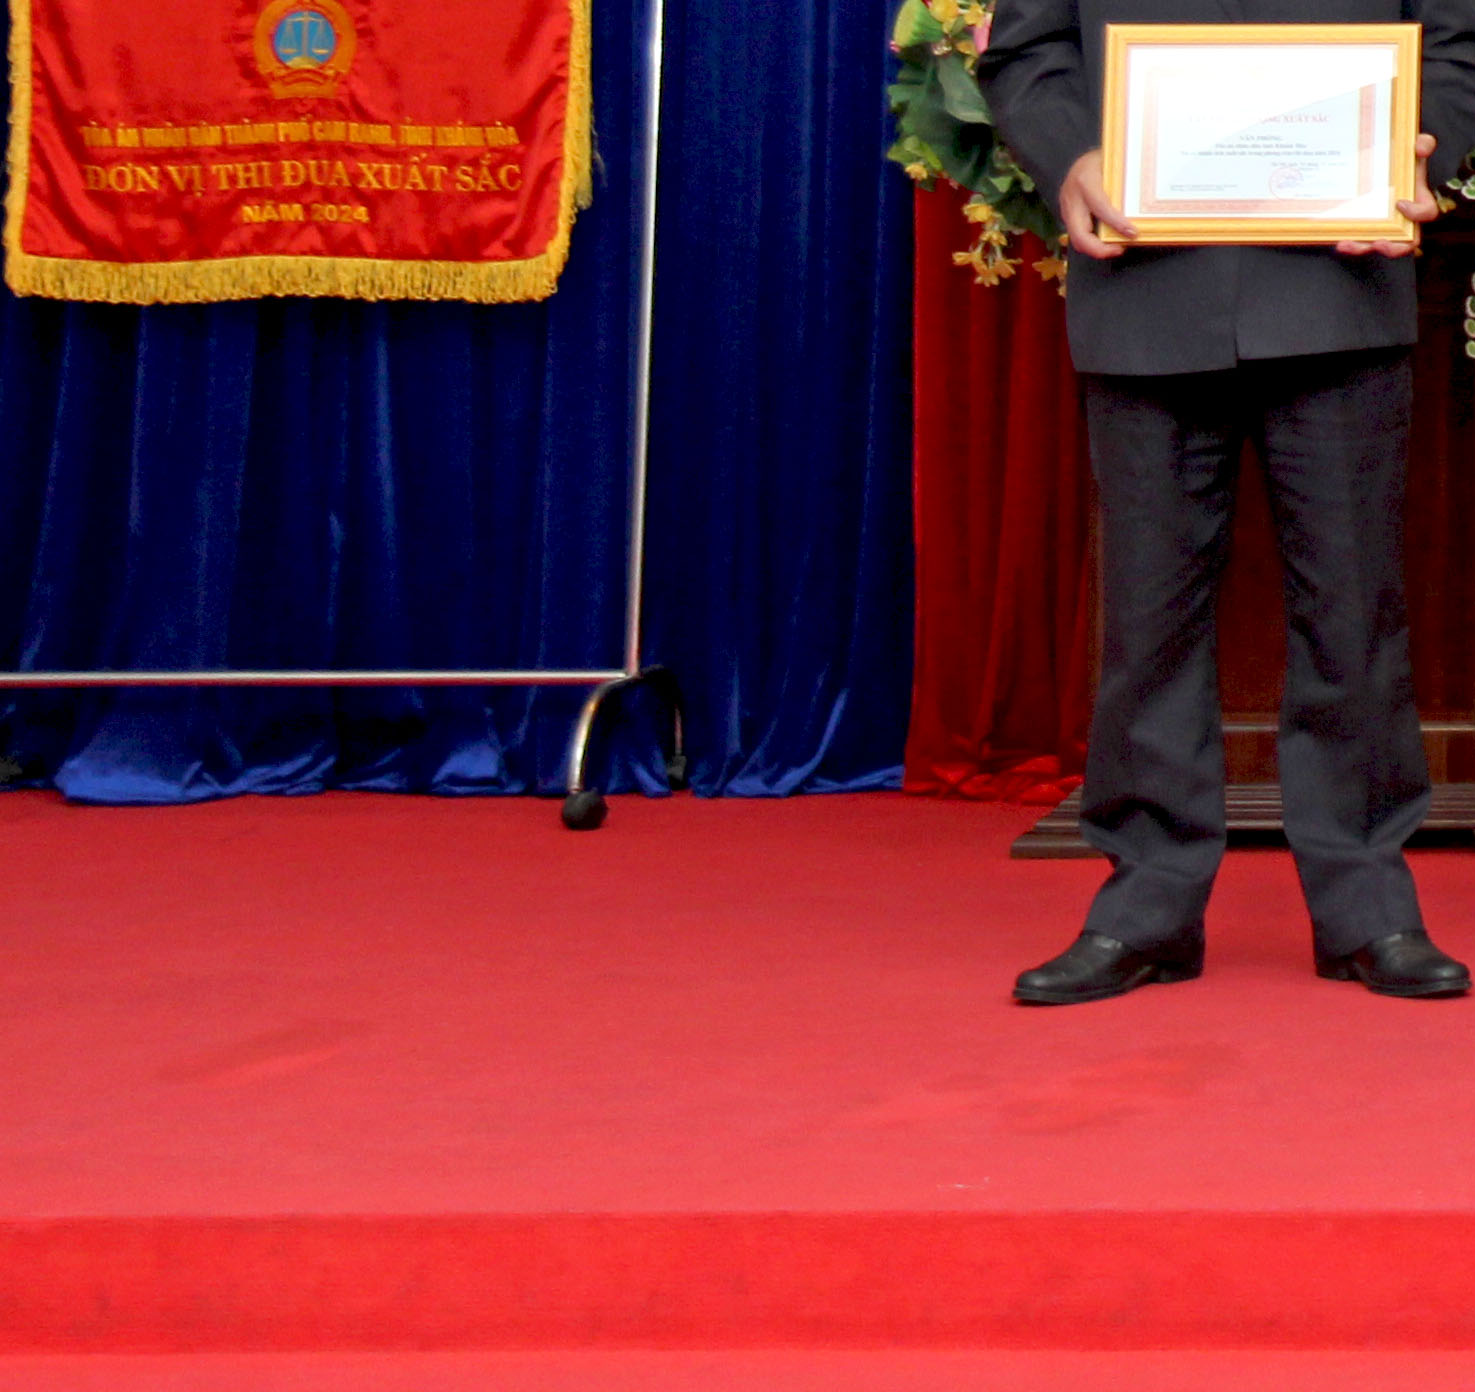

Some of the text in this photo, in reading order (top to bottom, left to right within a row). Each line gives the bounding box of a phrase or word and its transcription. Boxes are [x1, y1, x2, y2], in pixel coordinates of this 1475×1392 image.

[212, 160, 274, 191] THI
[281, 159, 352, 188] ĐUA
[356, 152, 449, 192] XUẤT
[454, 153, 523, 192] SẮC
[241, 200, 370, 224] NĂM 2024
